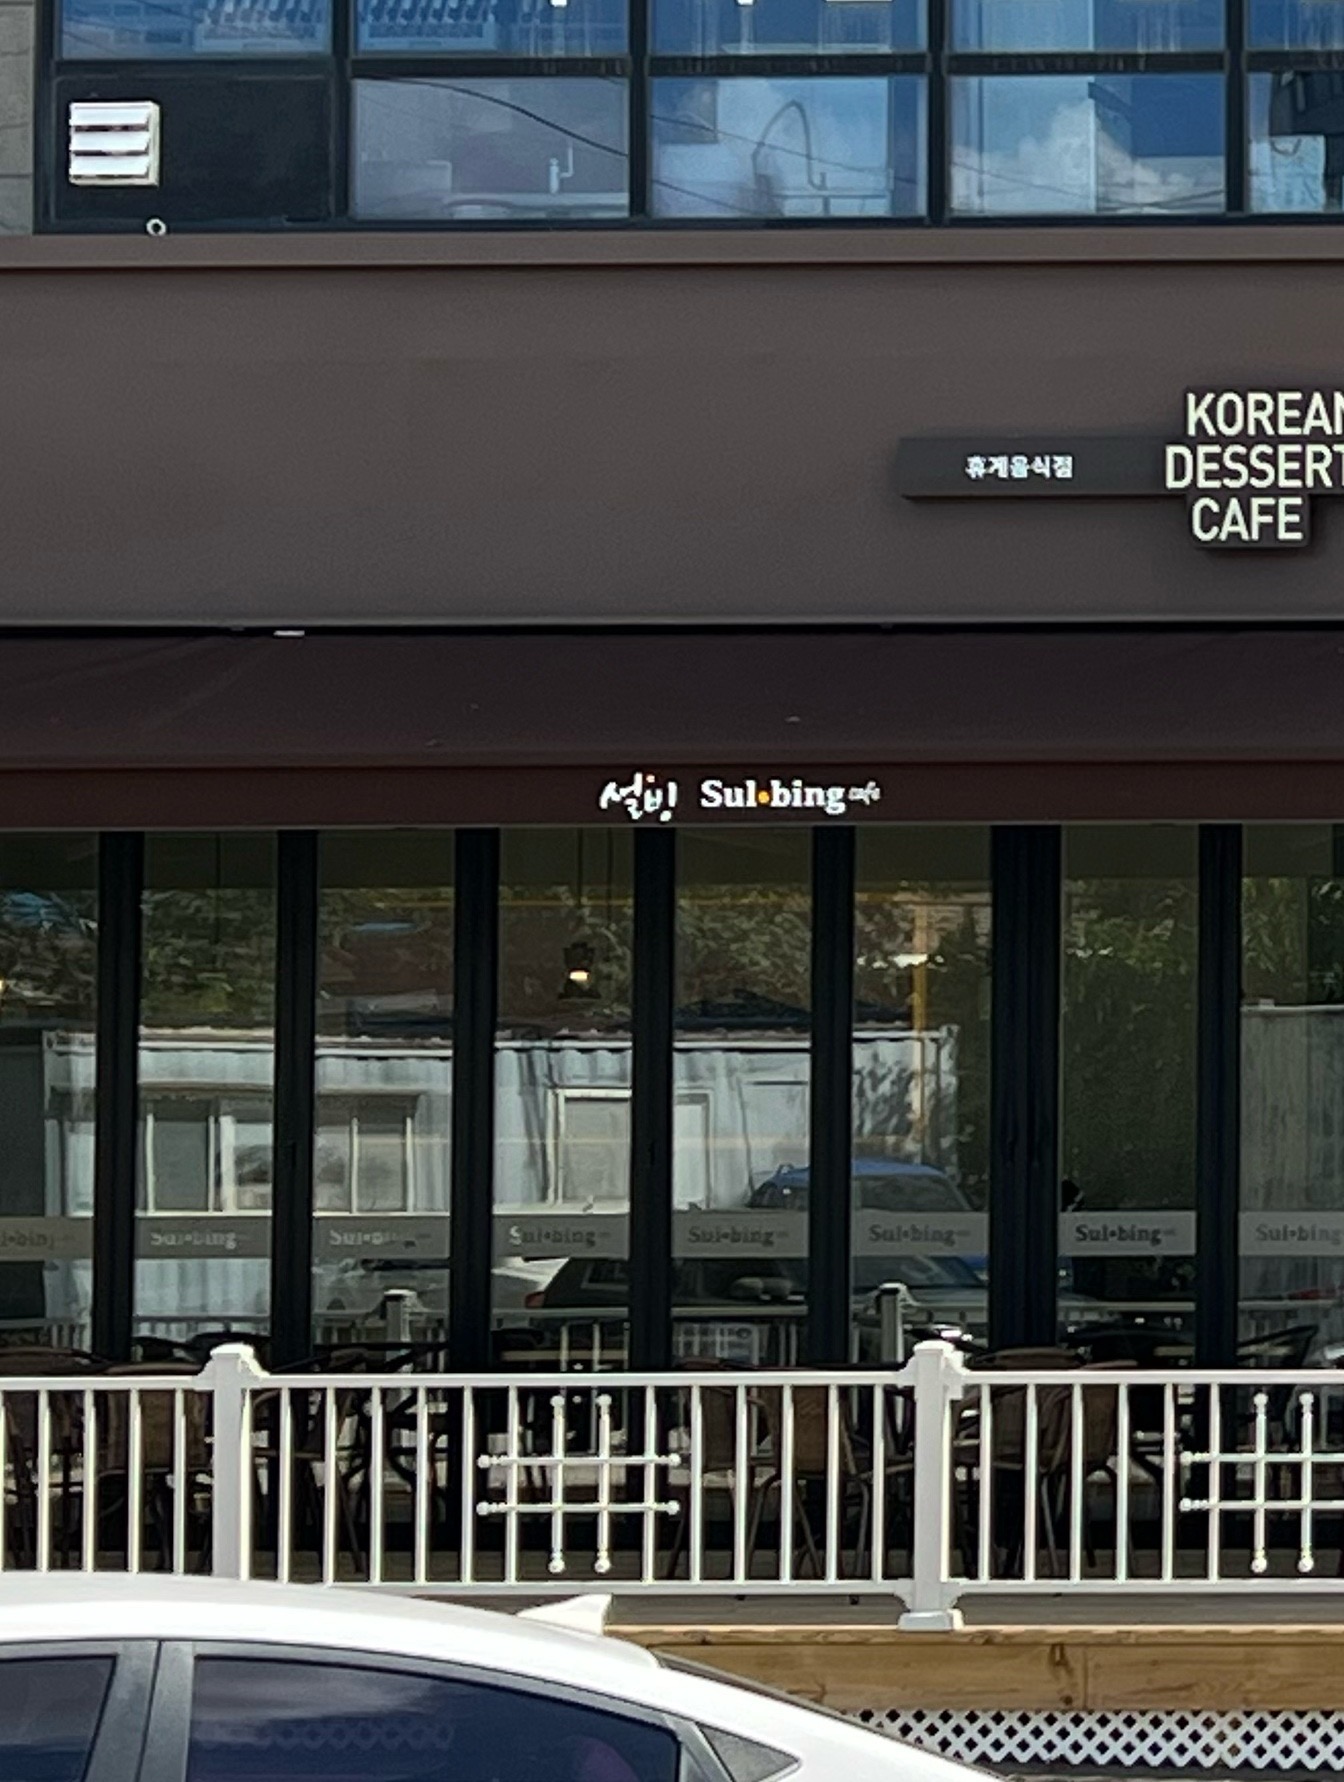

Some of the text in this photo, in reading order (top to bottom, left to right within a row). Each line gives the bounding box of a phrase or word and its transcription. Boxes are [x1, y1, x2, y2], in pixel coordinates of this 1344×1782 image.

[965, 454, 1073, 480] 휴게음식점
[1192, 497, 1304, 541] CAFE
[598, 772, 679, 823] 설빙
